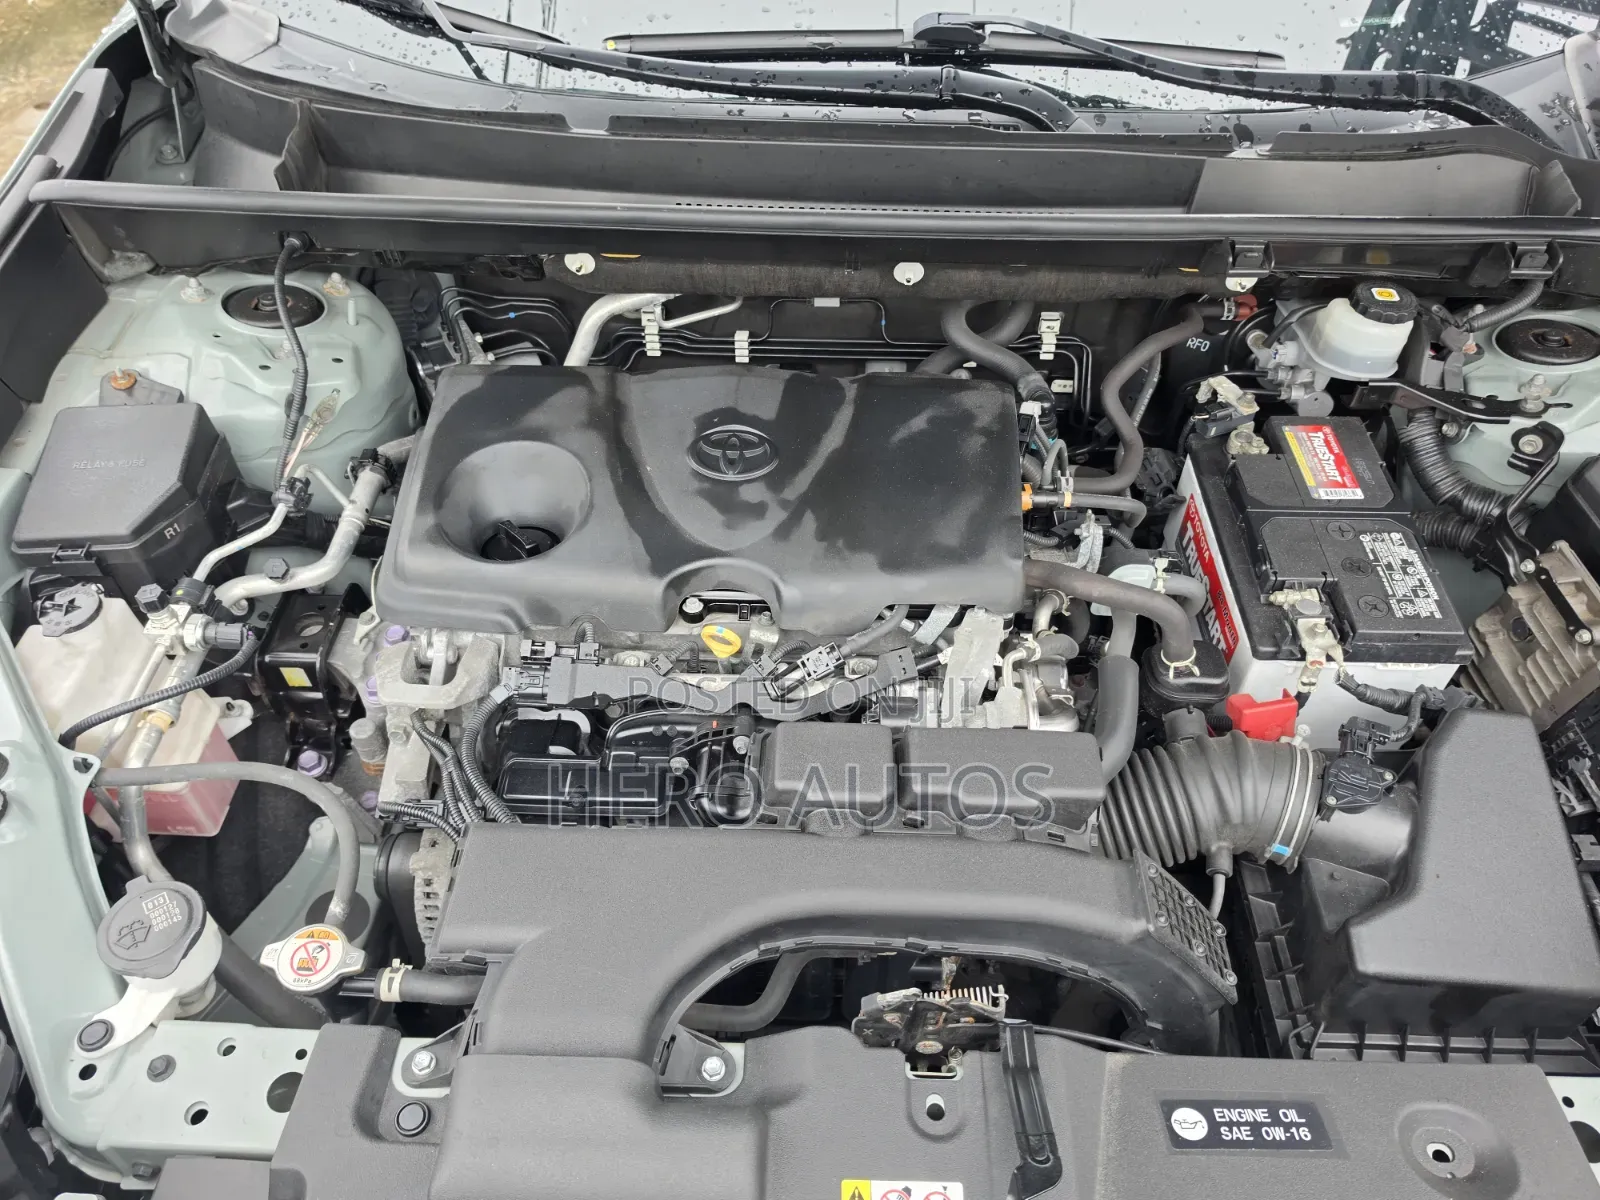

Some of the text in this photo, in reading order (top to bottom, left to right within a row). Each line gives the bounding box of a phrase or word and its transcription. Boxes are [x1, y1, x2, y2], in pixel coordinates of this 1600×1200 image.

[1325, 433, 1340, 454] TOYOTA
[163, 522, 181, 539] R1
[1194, 513, 1210, 563] TOYOTA
[1213, 1108, 1306, 1123] ENGINE OIL
[1220, 1126, 1254, 1141] SAE
